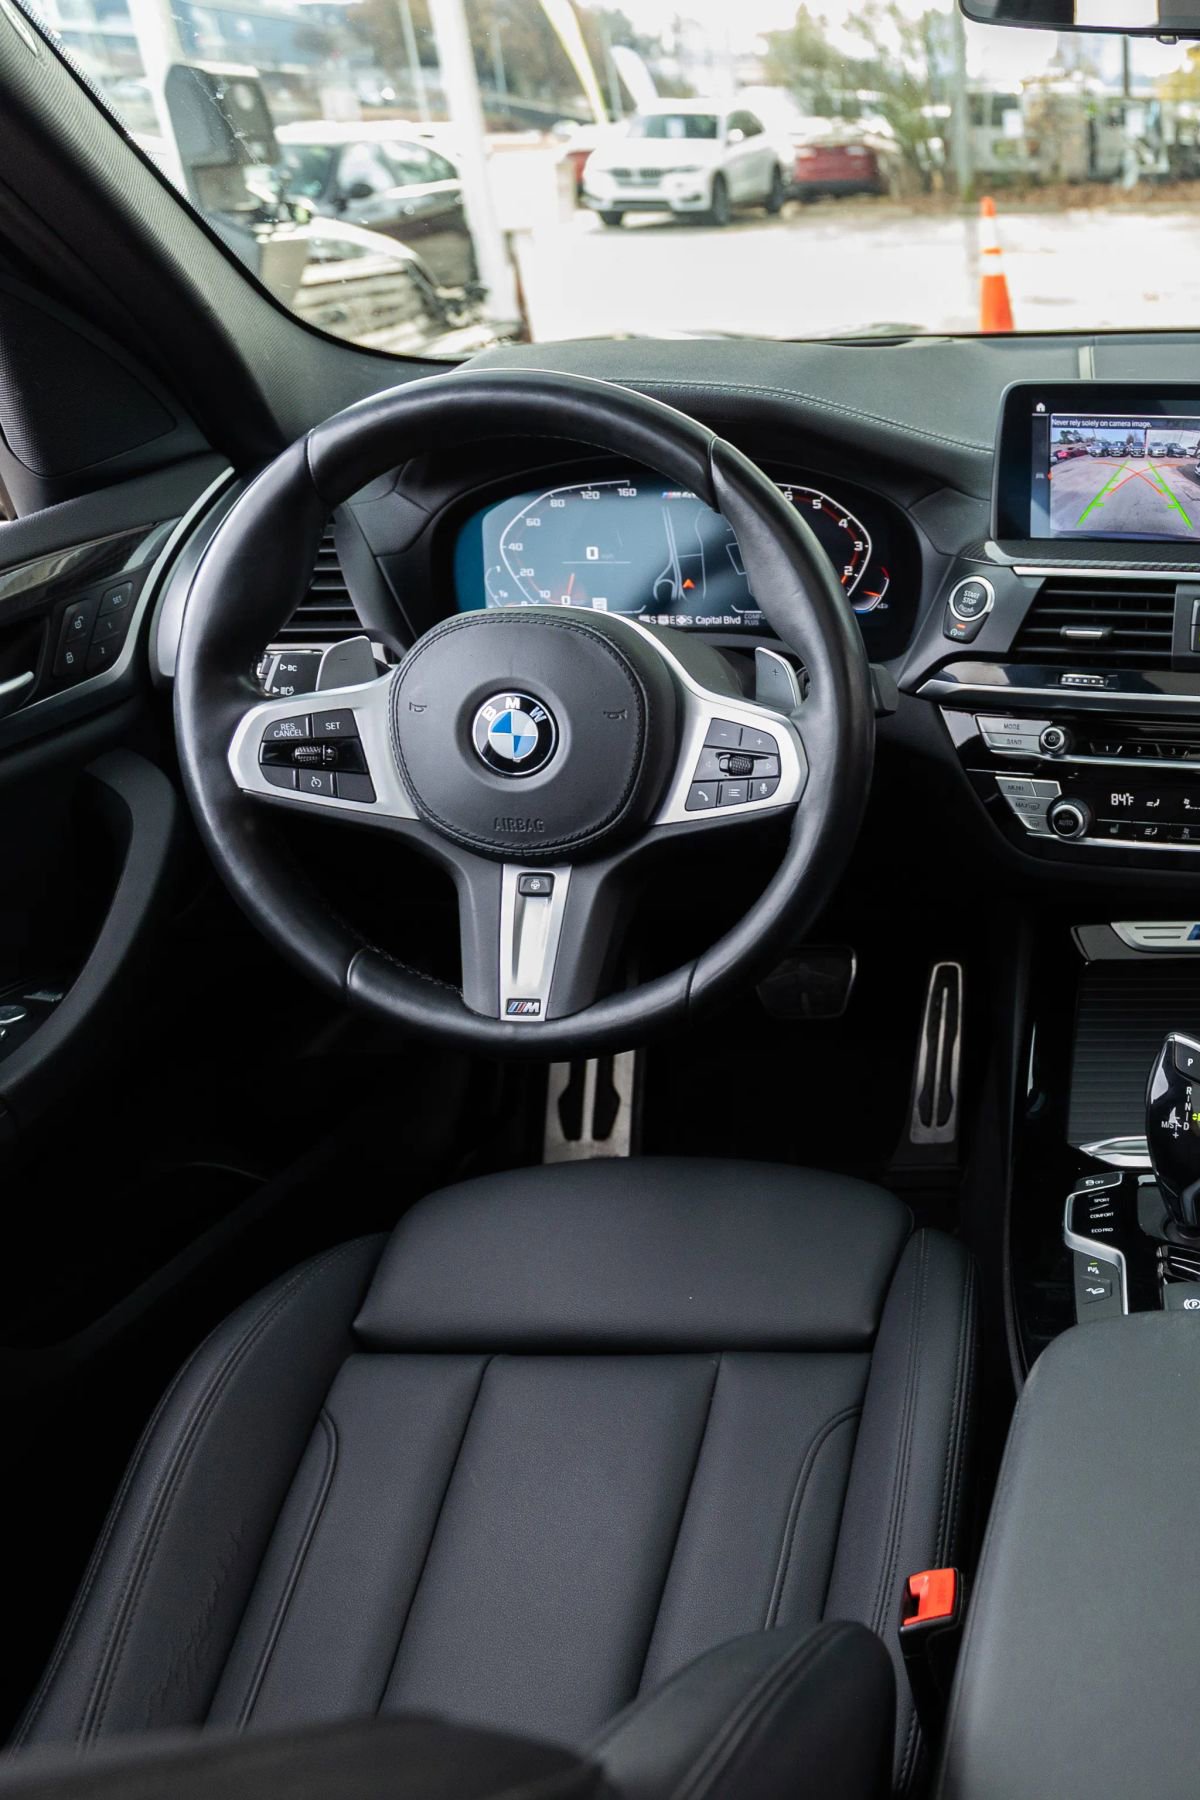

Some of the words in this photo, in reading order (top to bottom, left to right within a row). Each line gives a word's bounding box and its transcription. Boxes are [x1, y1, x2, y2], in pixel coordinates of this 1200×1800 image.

[1081, 420, 1100, 428] solely
[580, 491, 600, 500] 120
[617, 488, 637, 497] 160
[550, 499, 565, 508] 80
[812, 499, 822, 510] 5
[526, 518, 541, 527] 60
[838, 518, 849, 528] 4
[508, 543, 523, 551] 40
[854, 541, 863, 551] 3
[586, 546, 599, 560] 0
[520, 568, 534, 577] 20
[844, 565, 853, 576] 2
[538, 590, 551, 599] 10
[963, 589, 980, 599] START
[961, 597, 977, 605] STOP
[669, 616, 675, 625] E
[695, 615, 722, 627] Capital
[723, 615, 741, 625] Blvd
[482, 696, 547, 723] BMW
[280, 723, 296, 731] RES
[325, 721, 341, 731] SET
[273, 729, 304, 738] CANCEL
[493, 817, 545, 833] AIRBAG
[522, 1001, 540, 1013] M
[1187, 1058, 1194, 1067] P
[1186, 1086, 1193, 1096] R
[1184, 1102, 1192, 1112] N
[1183, 1121, 1190, 1131] D
[1089, 1211, 1114, 1219] COMFORT
